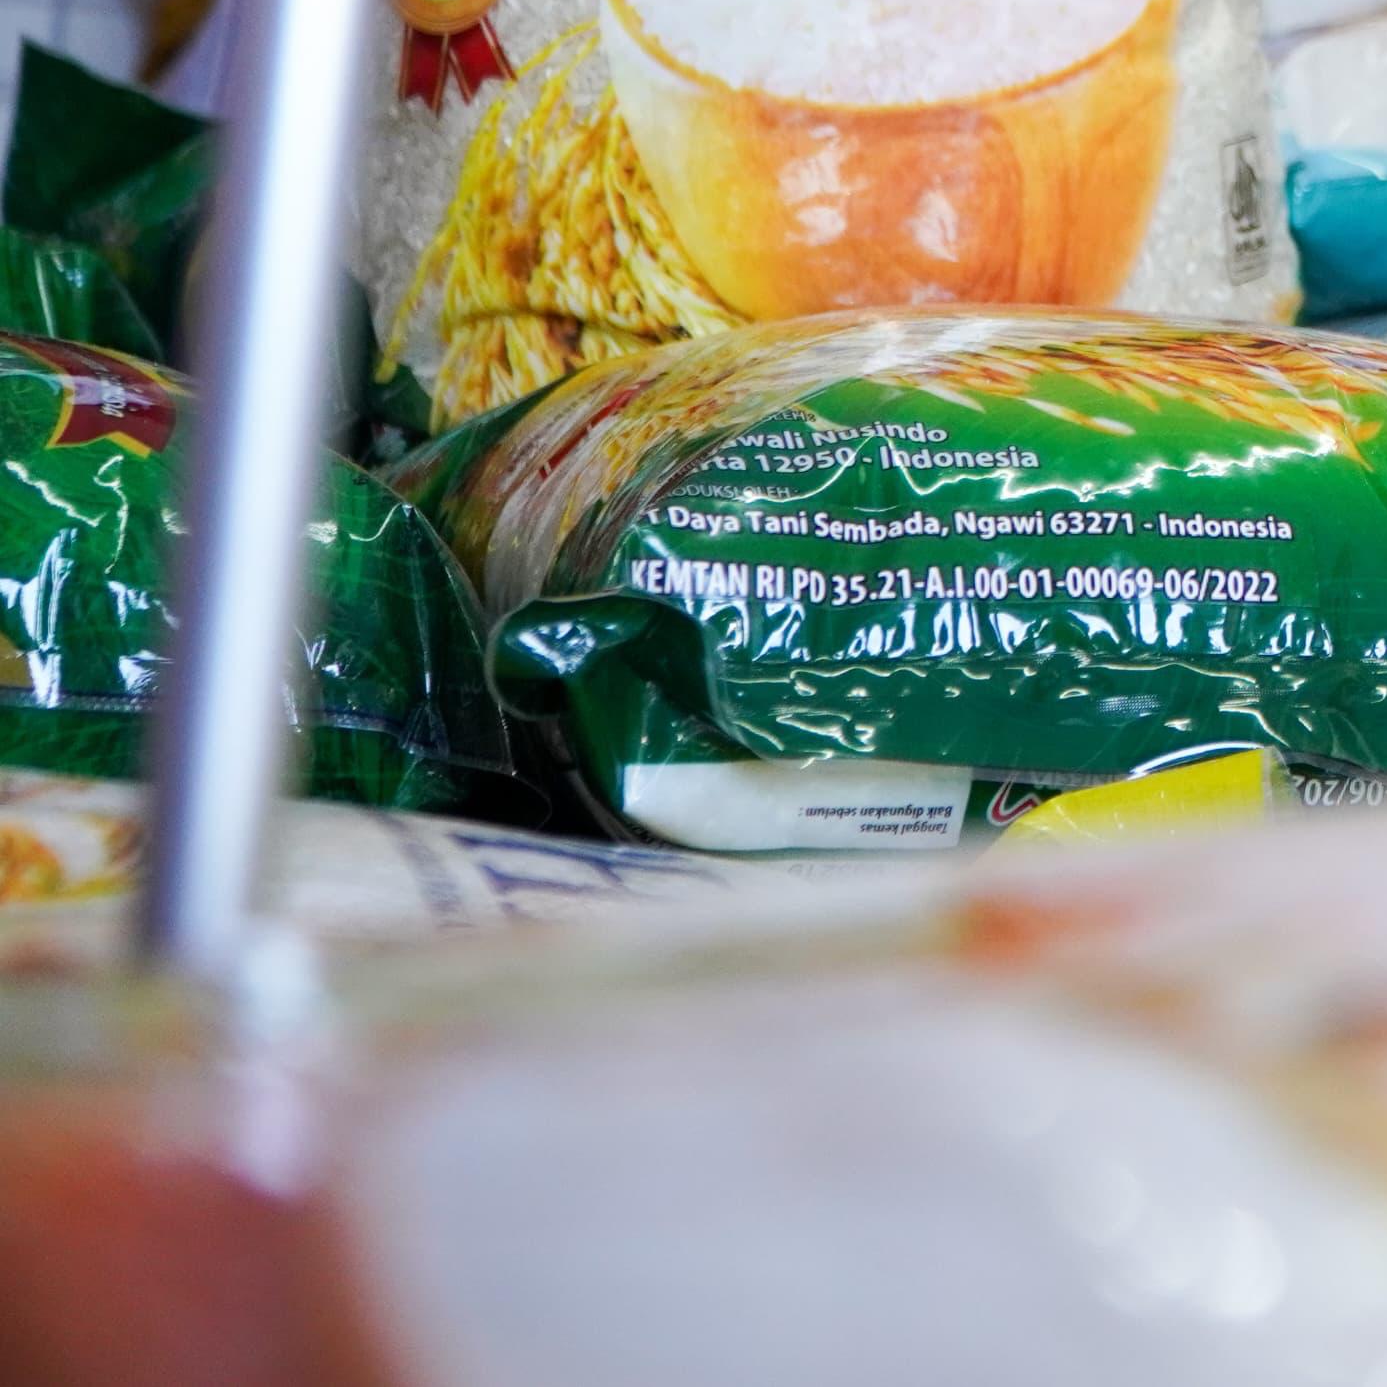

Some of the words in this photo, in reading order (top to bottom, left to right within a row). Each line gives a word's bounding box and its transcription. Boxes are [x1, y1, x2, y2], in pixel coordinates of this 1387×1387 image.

[812, 421, 947, 447] Nusindo
[755, 447, 856, 473] 12950
[881, 445, 1039, 471] Indonesia
[667, 505, 741, 536] Daya
[745, 510, 808, 535] Tani
[814, 511, 949, 543] Sembada,
[954, 510, 1044, 539] Ngawi
[1050, 511, 1134, 536] 63271
[1159, 513, 1293, 540] Indonesia
[630, 559, 749, 596] KEMTAN
[756, 565, 784, 599] RI
[792, 570, 826, 604] PD
[806, 806, 857, 819] sebelum
[860, 804, 923, 819] digunakan
[928, 804, 953, 819] Baik
[860, 823, 899, 835] kemas
[902, 820, 948, 835] Tanggal
